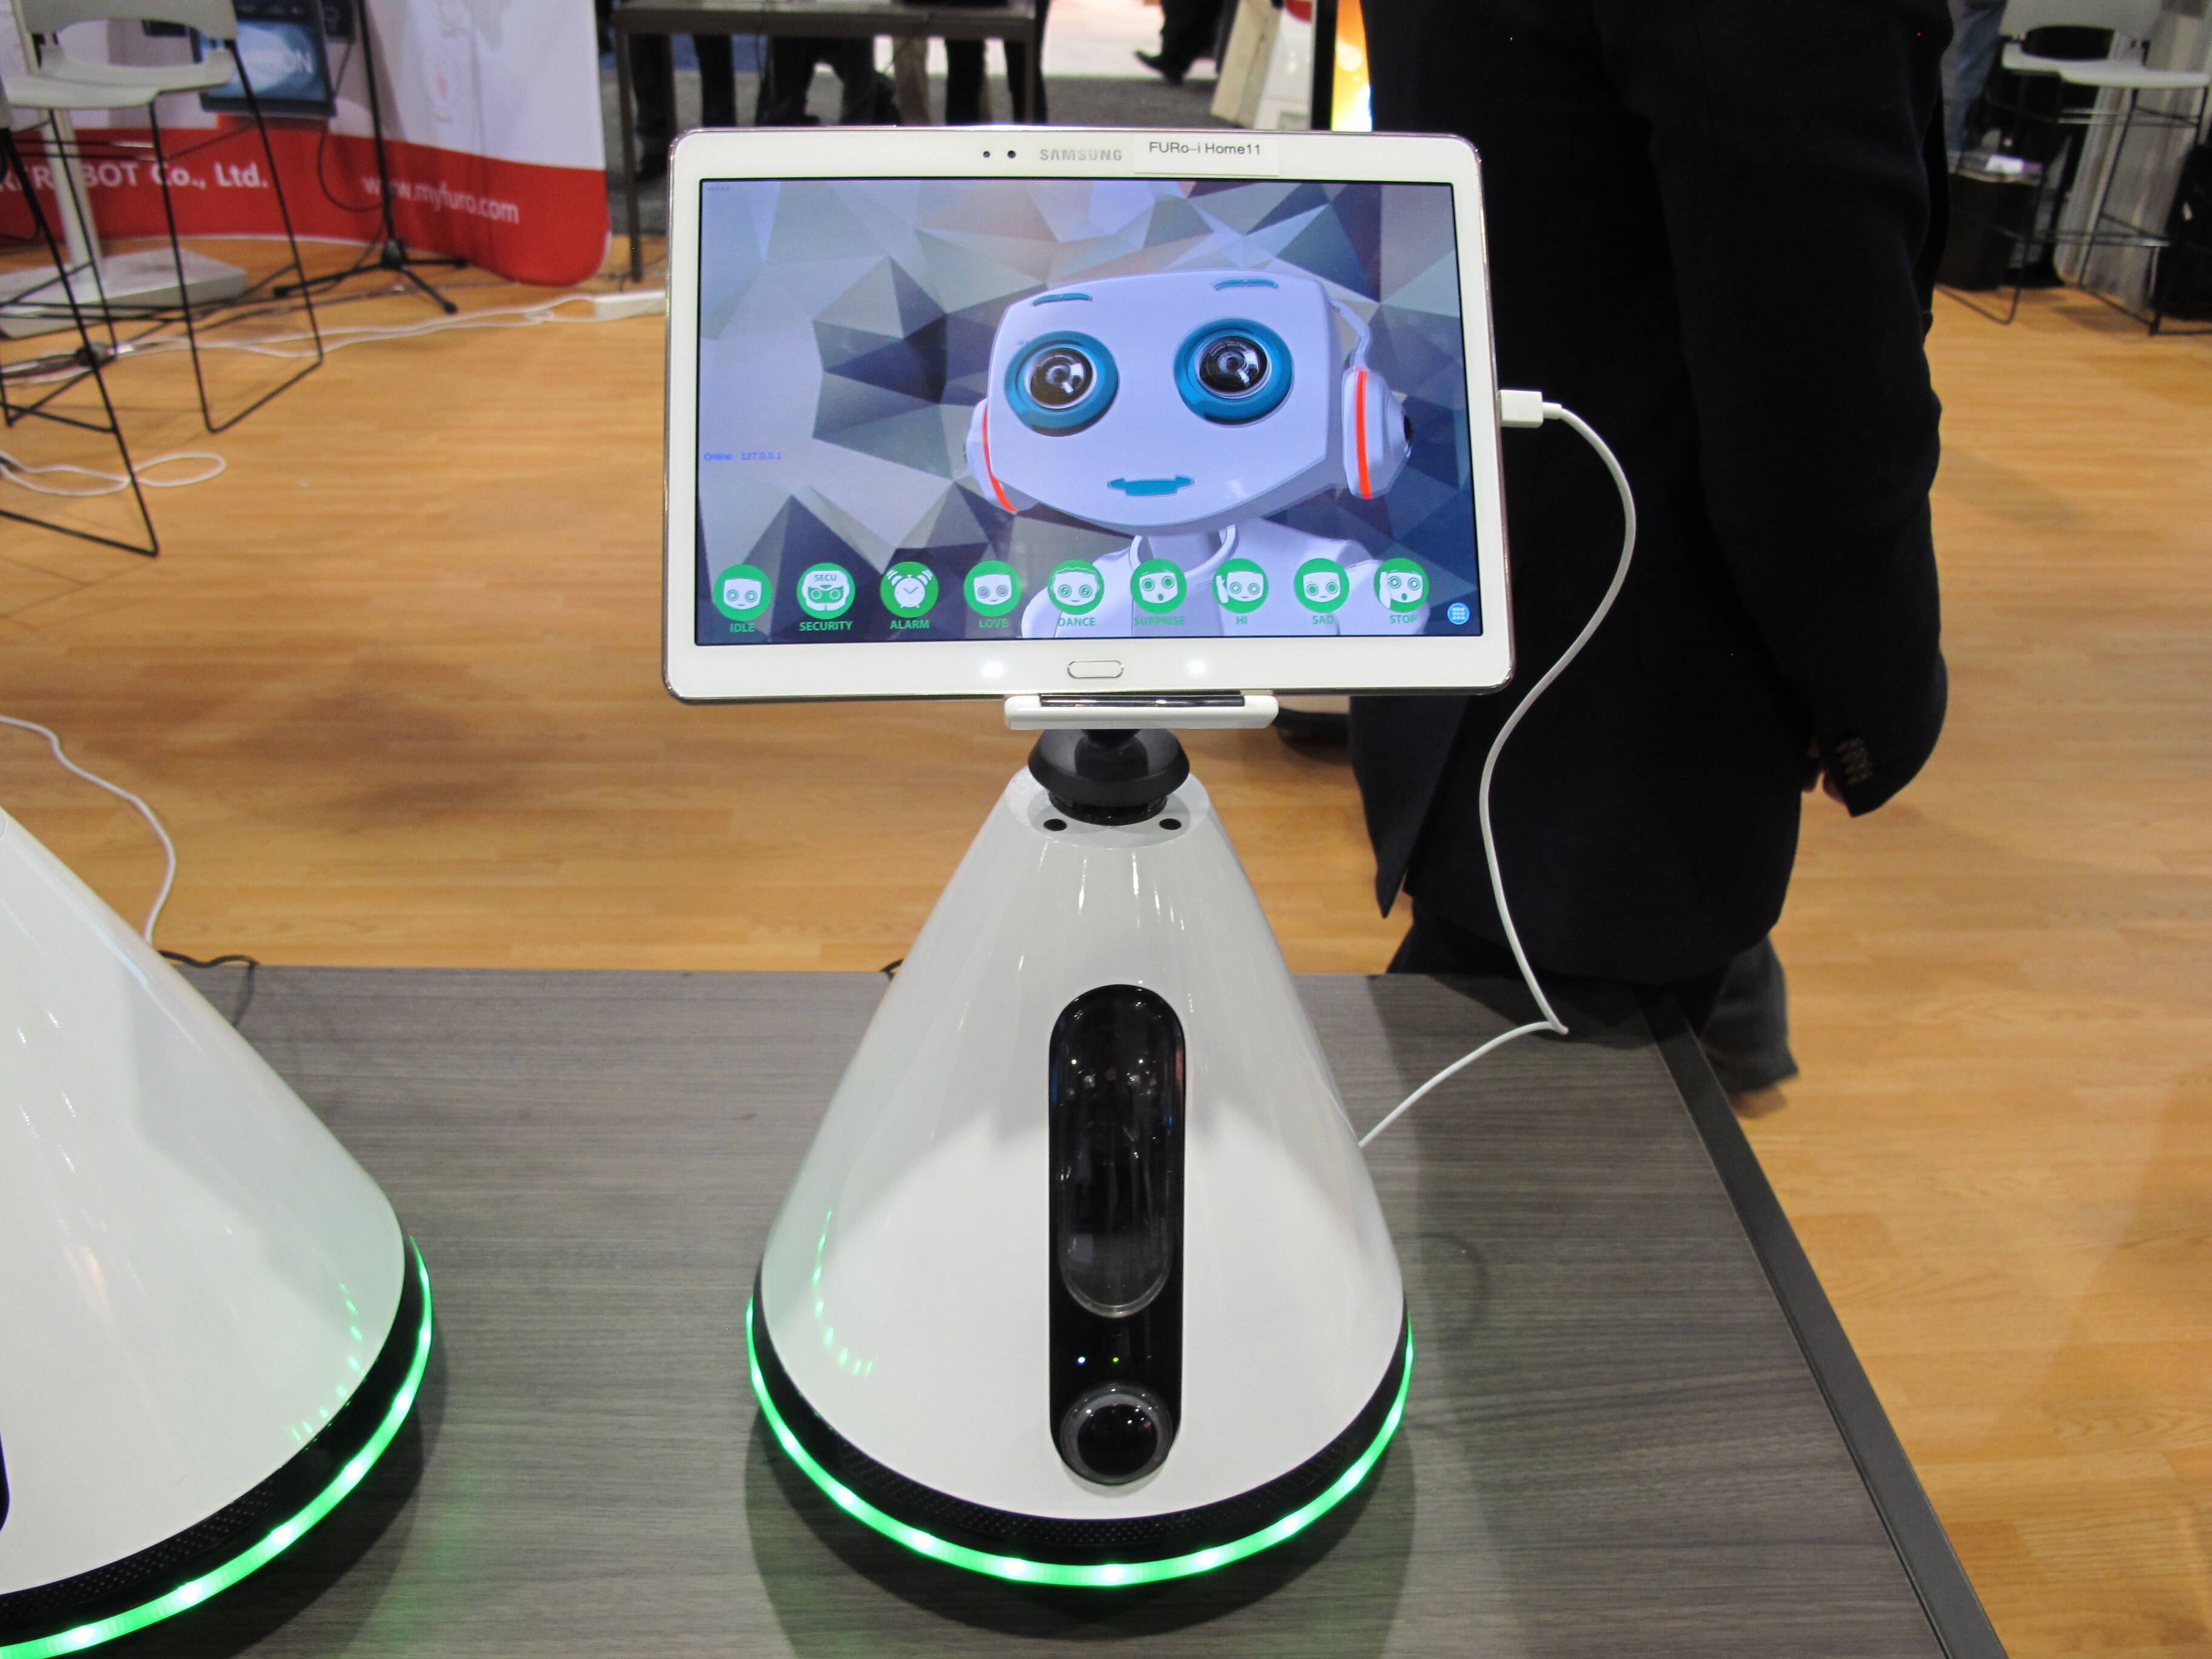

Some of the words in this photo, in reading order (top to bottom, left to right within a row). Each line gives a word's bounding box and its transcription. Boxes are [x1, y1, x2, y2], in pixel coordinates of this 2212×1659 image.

[1149, 141, 1201, 154] FURo-i
[1205, 143, 1261, 155] Home11
[1039, 149, 1122, 161] SAMSUNG
[214, 161, 269, 188] Ltd.
[890, 620, 930, 630] ALARM
[979, 618, 1008, 628] LOVE
[1057, 617, 1096, 627] DANCE
[1134, 616, 1185, 626] SURPRISE
[1236, 616, 1247, 625] HI
[1312, 615, 1335, 625] SAD
[1389, 615, 1417, 625] STOP
[729, 623, 756, 632] IDLE
[799, 621, 853, 632] SECURITY
